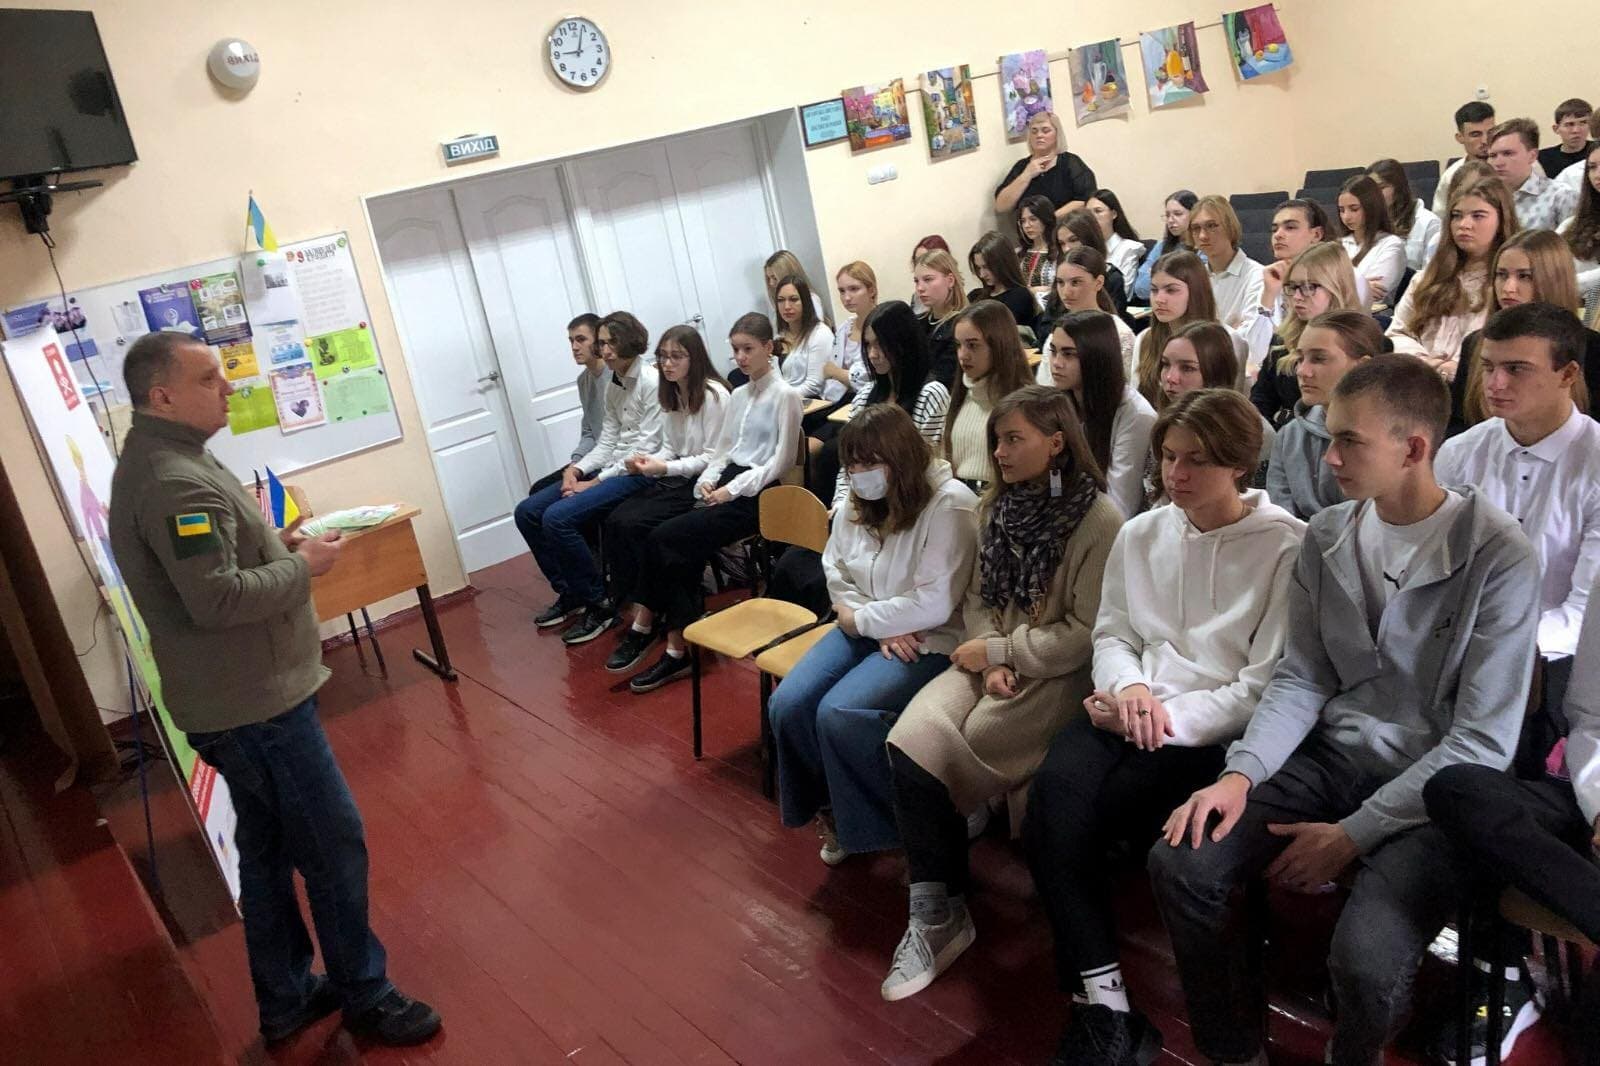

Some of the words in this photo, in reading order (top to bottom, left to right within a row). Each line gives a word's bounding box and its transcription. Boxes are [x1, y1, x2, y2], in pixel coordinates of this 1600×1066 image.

[567, 22, 577, 31] 12
[559, 27, 568, 36] 11
[590, 32, 597, 41] 2
[552, 37, 563, 47] 10
[596, 44, 603, 53] 3
[553, 50, 561, 60] 9
[596, 57, 603, 66] 4
[559, 62, 567, 72] 8
[569, 71, 576, 80] 7
[590, 68, 598, 76] 5
[580, 73, 587, 81] 6
[450, 138, 495, 157] ВИХІД
